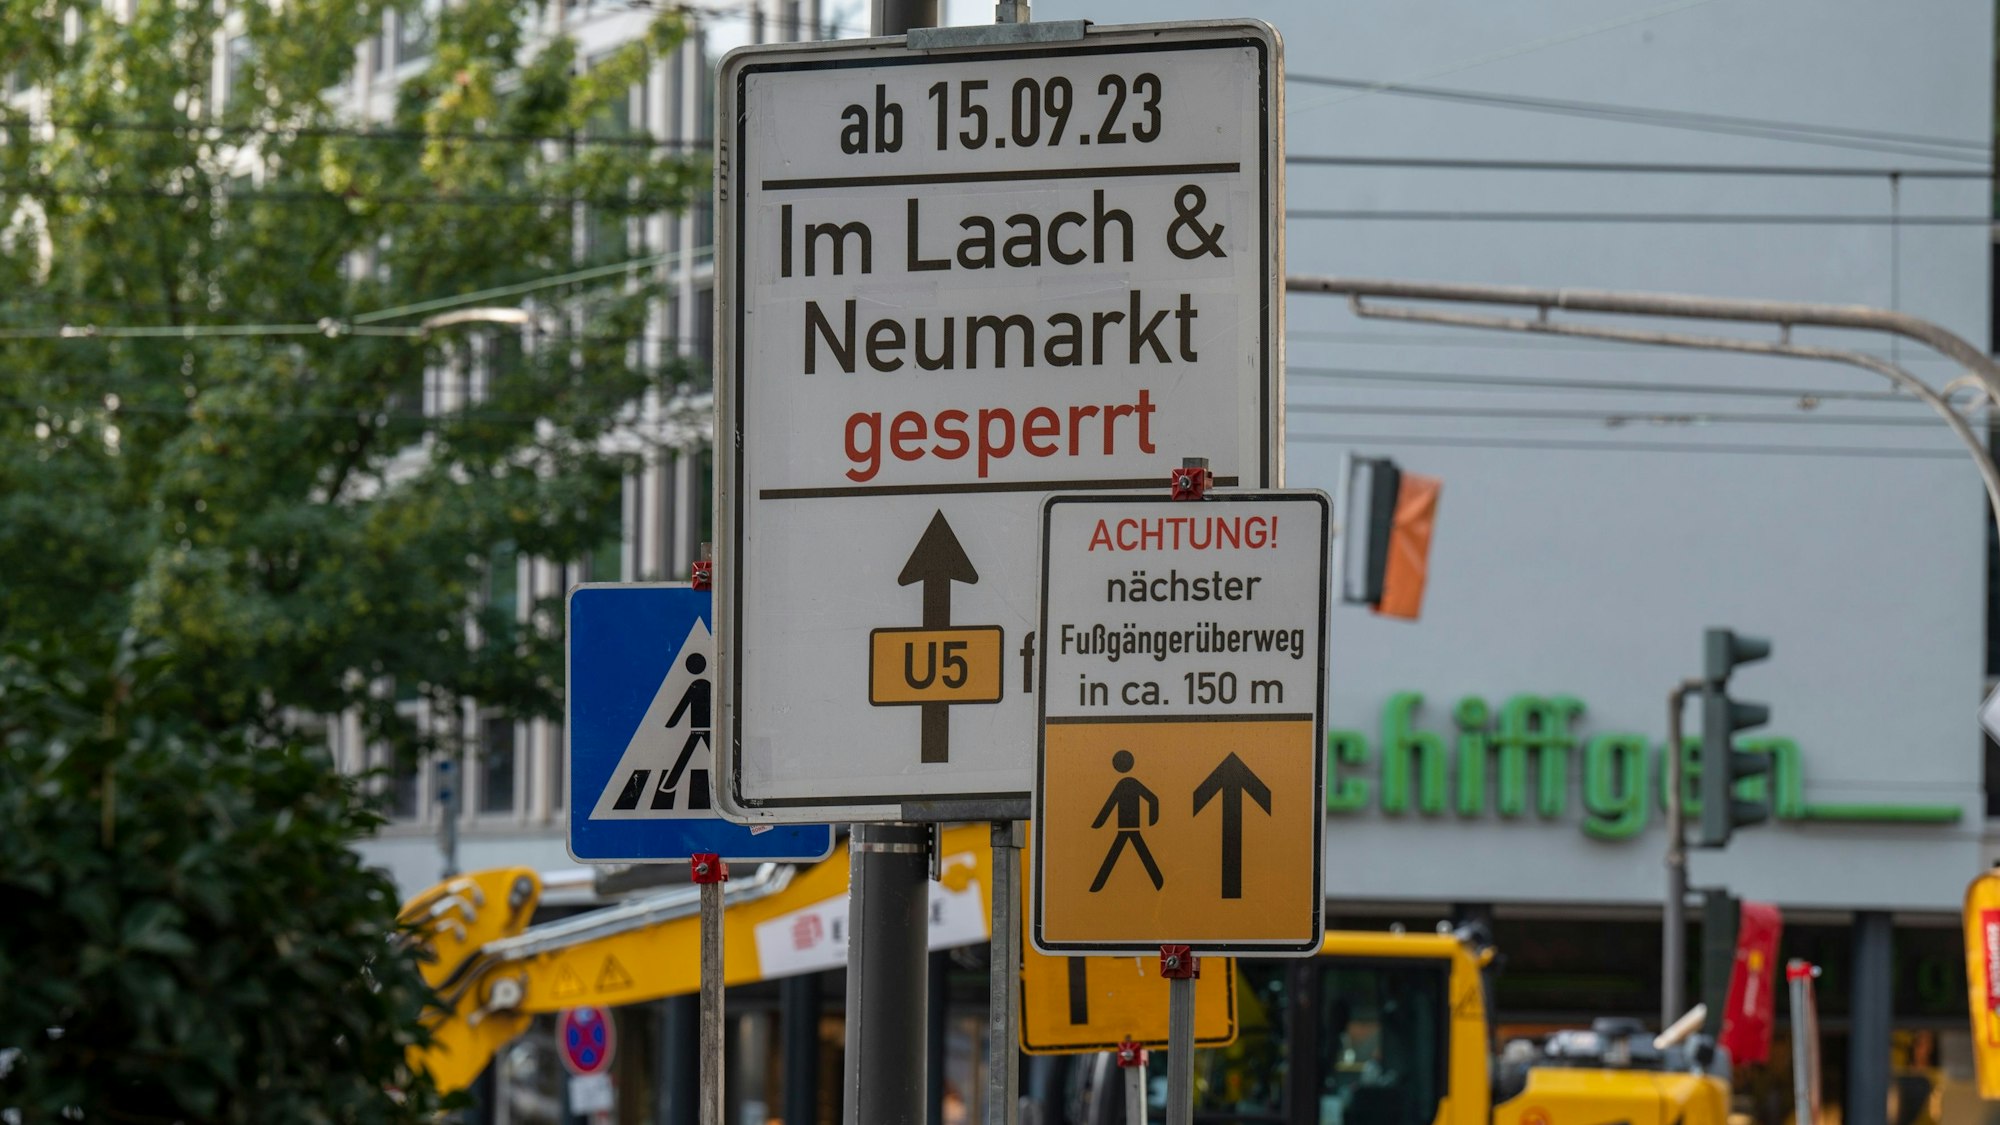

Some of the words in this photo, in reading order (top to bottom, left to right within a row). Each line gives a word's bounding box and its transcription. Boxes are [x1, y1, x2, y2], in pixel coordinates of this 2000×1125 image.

[841, 84, 903, 155] ab
[929, 73, 1162, 151] 15.09.23
[781, 204, 872, 278] Im
[907, 189, 1134, 272] Laach
[1167, 184, 1227, 260] &
[804, 290, 1198, 375] Neumarkt
[845, 390, 1156, 482] gesperrt
[1088, 516, 1278, 551] ACHTUNG!
[1107, 570, 1262, 603] nächster
[904, 641, 968, 690] U5
[1061, 622, 1304, 662] Fußgängerüberweg
[1080, 674, 1108, 706] in
[1121, 682, 1169, 706] ca.
[1184, 672, 1237, 705] 150
[1251, 680, 1283, 704] m
[1327, 690, 1803, 839] chiffgen
